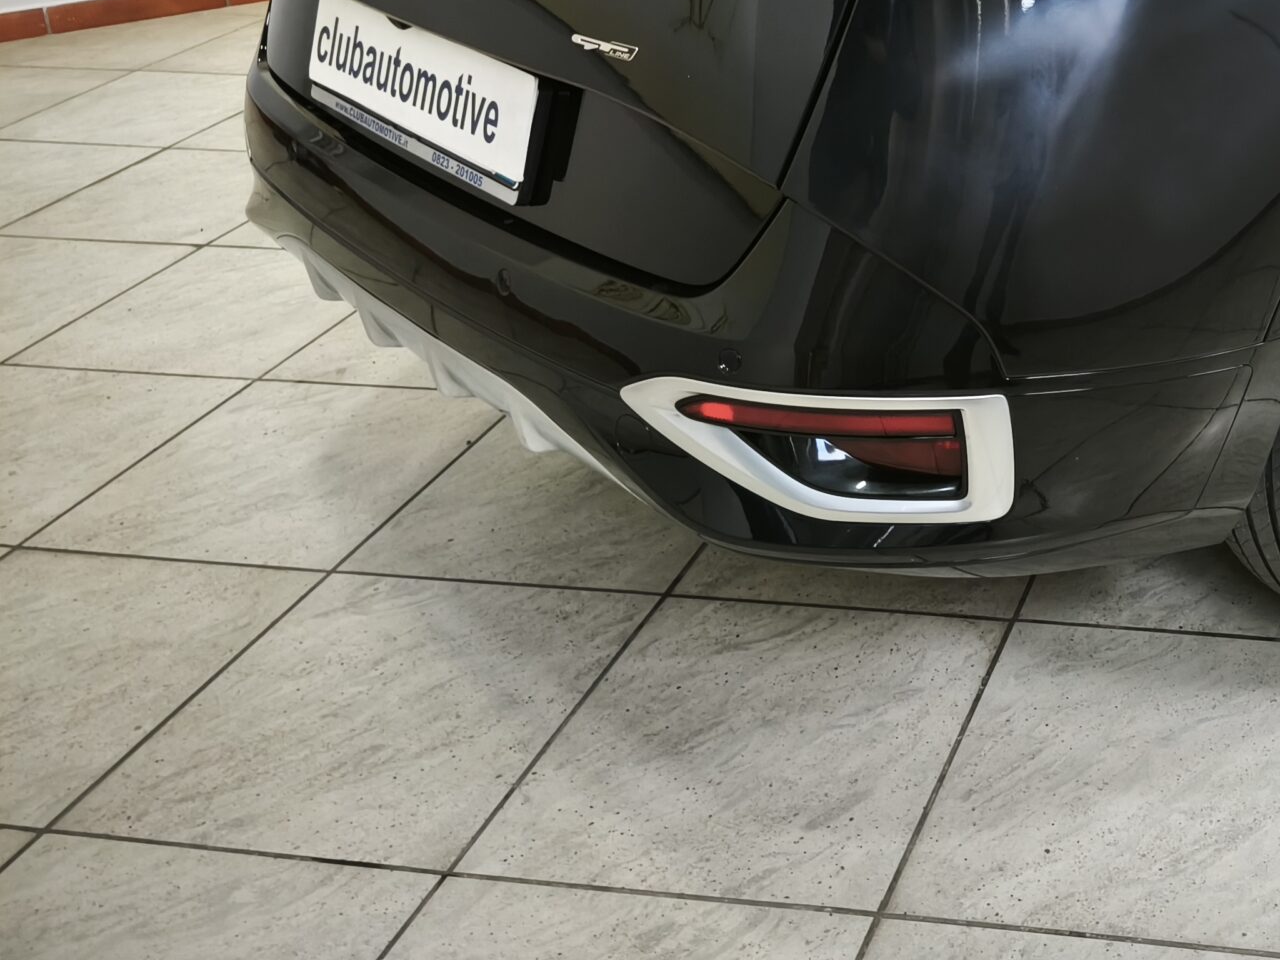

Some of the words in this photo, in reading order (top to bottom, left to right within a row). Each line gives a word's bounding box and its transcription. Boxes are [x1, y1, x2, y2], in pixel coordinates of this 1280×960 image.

[316, 16, 500, 144] clubautomotive
[431, 151, 450, 171] 0823
[455, 164, 483, 188] 201005
